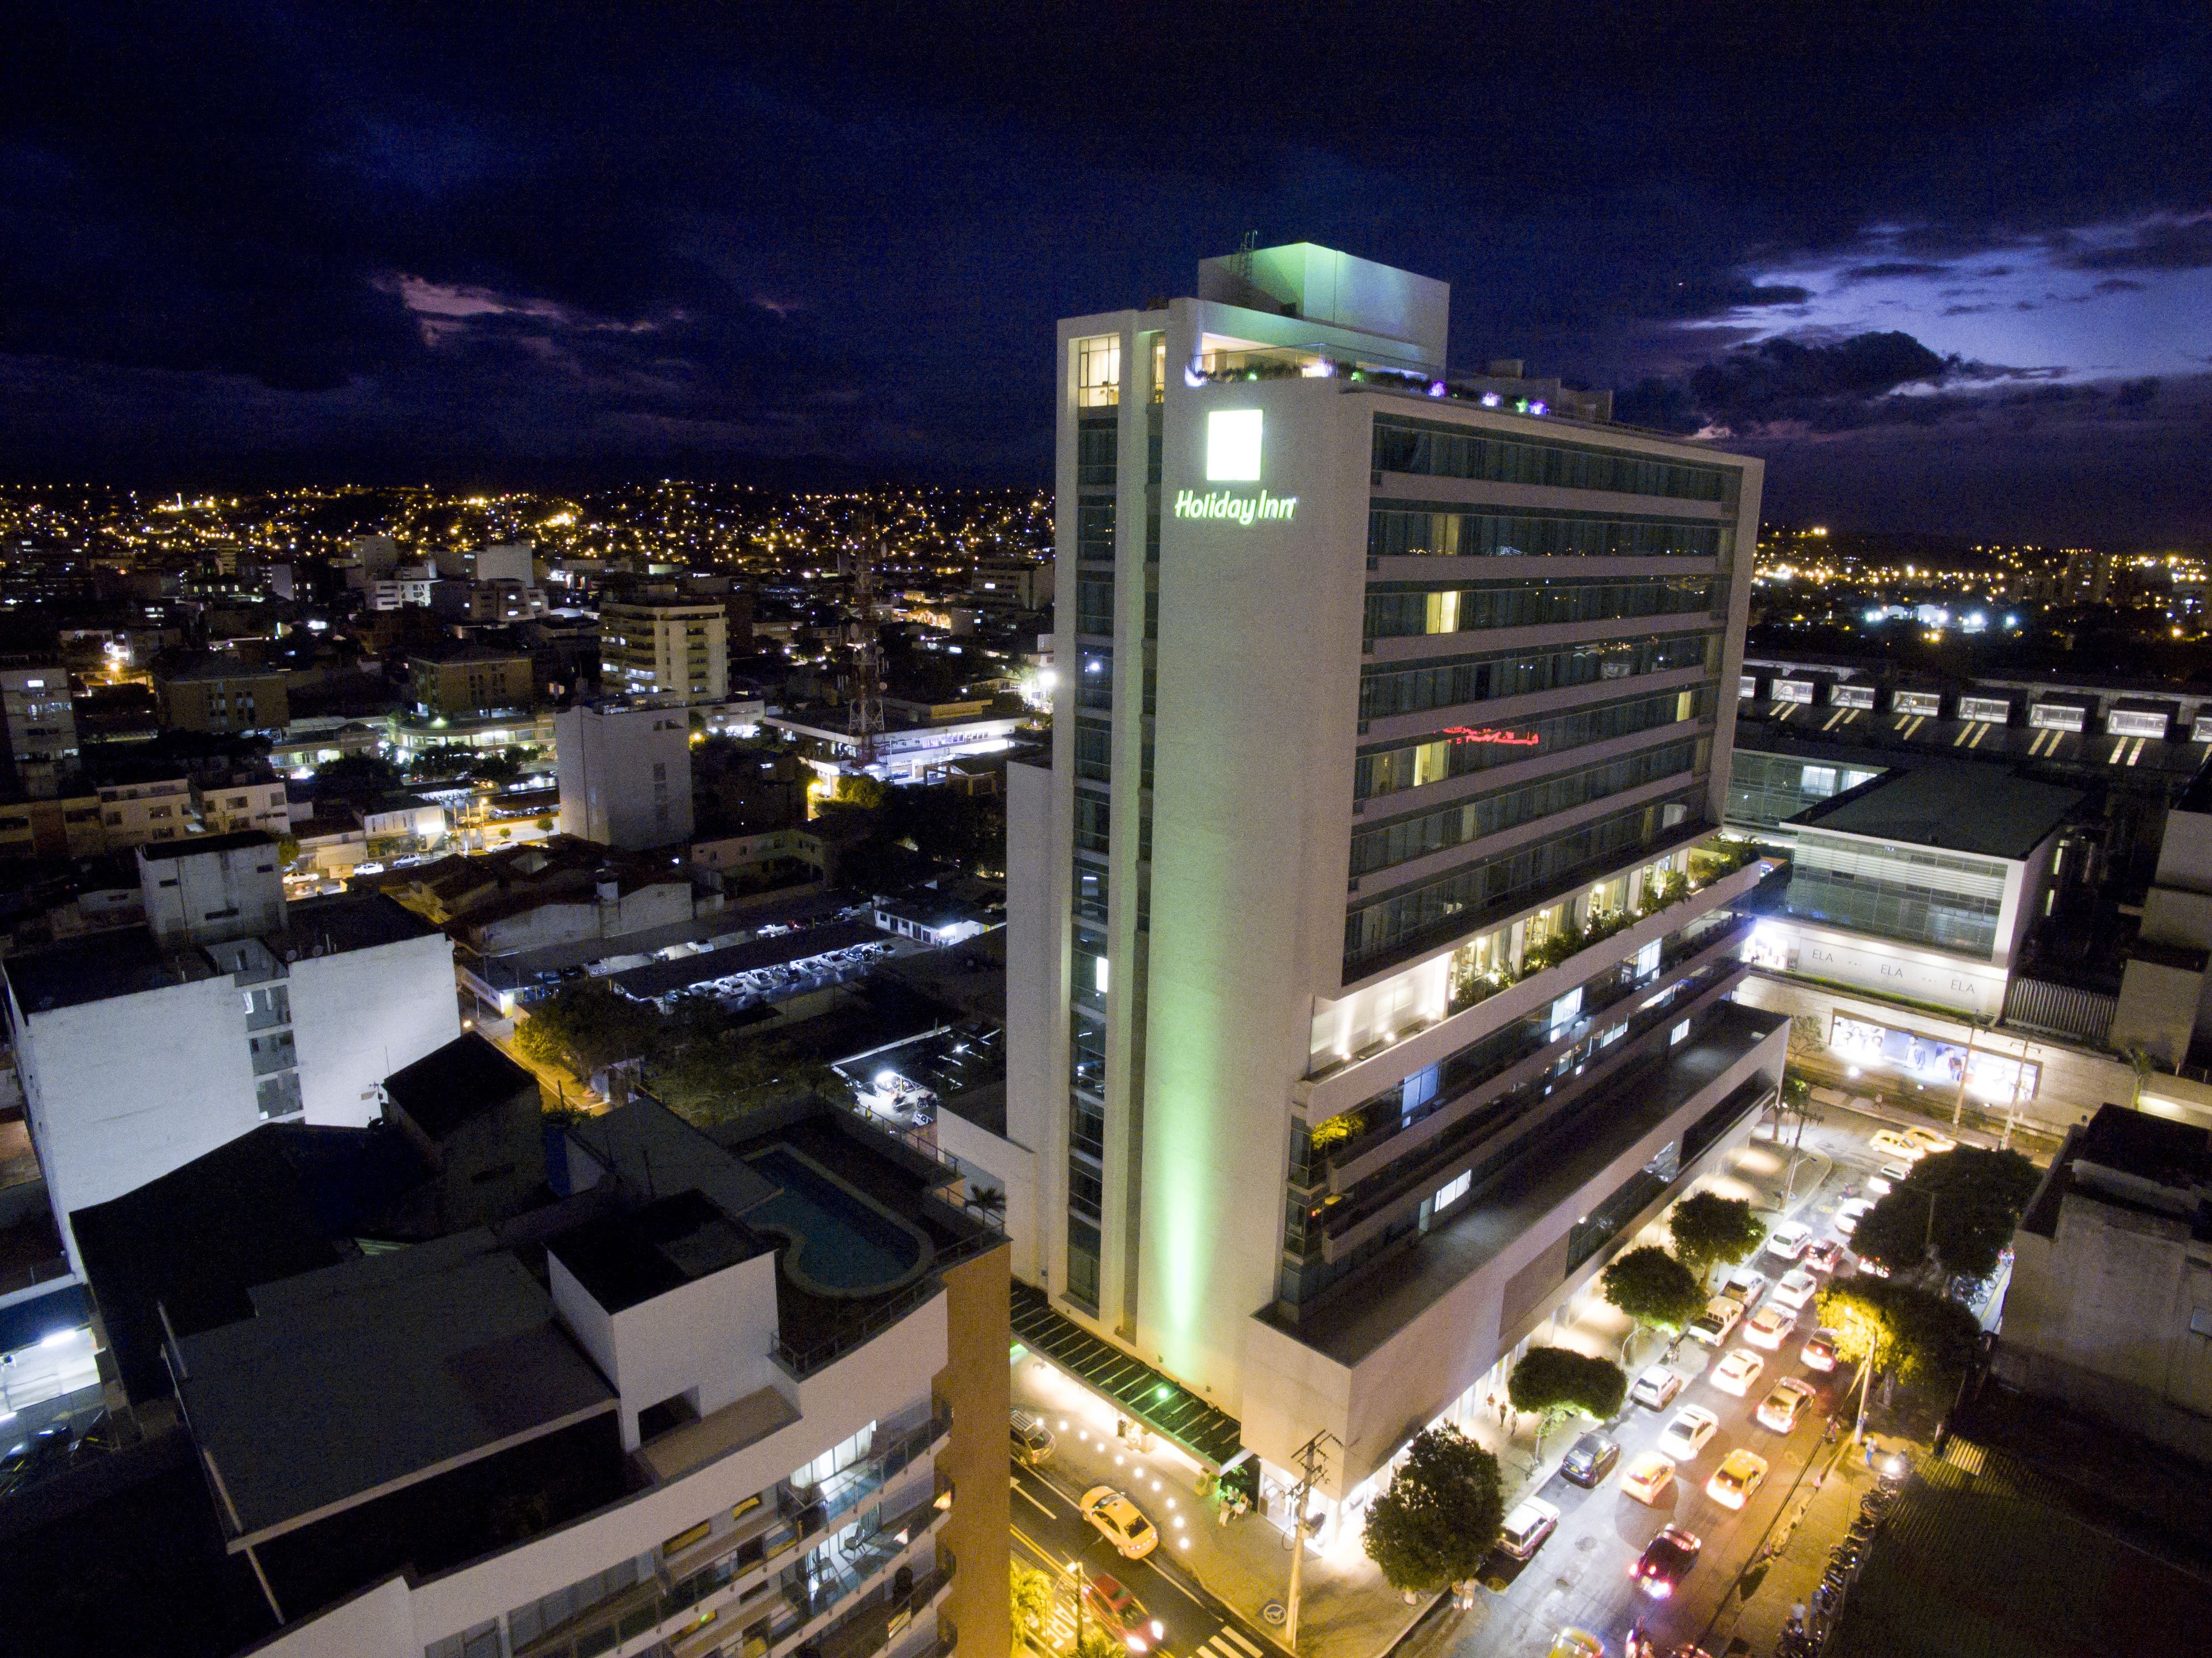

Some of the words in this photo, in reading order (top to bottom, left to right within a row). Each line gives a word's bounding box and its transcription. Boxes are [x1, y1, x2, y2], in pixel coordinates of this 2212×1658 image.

[1175, 490, 1256, 525] Holiday
[1258, 490, 1295, 518] Inn
[1812, 949, 1833, 963] ELA
[1880, 964, 1903, 978] ELA
[1951, 979, 1975, 994] ELA
